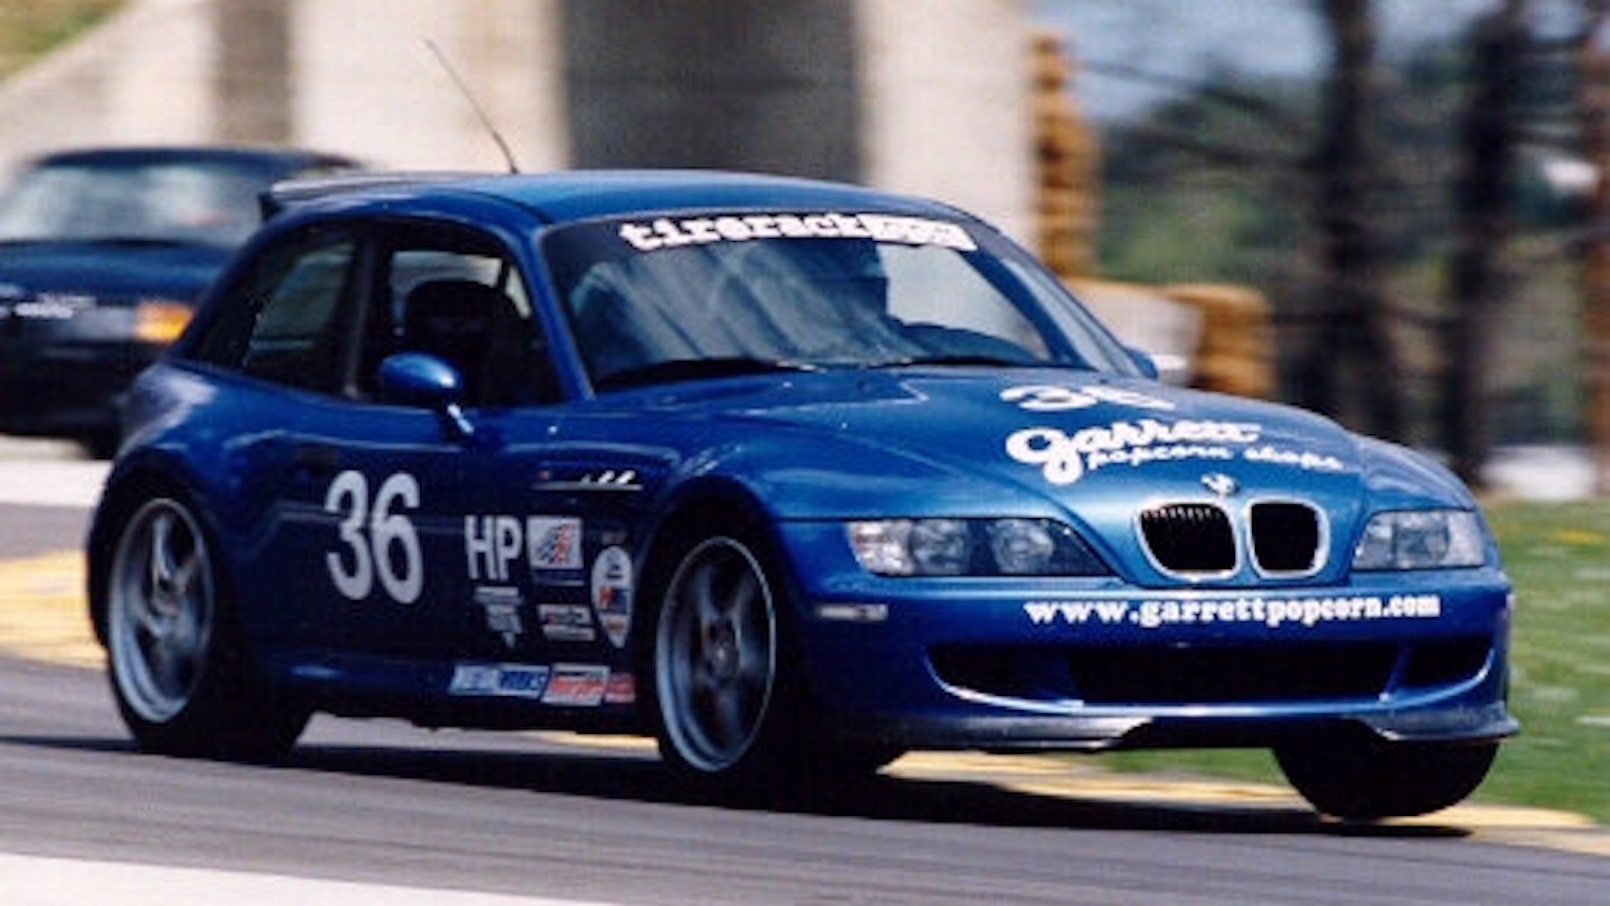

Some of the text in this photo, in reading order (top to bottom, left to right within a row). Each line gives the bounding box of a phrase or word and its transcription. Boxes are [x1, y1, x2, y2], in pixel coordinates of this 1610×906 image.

[324, 469, 424, 604] 36
[463, 514, 524, 581] HP
[1024, 596, 1441, 627] www.garrettpopcorn.com
